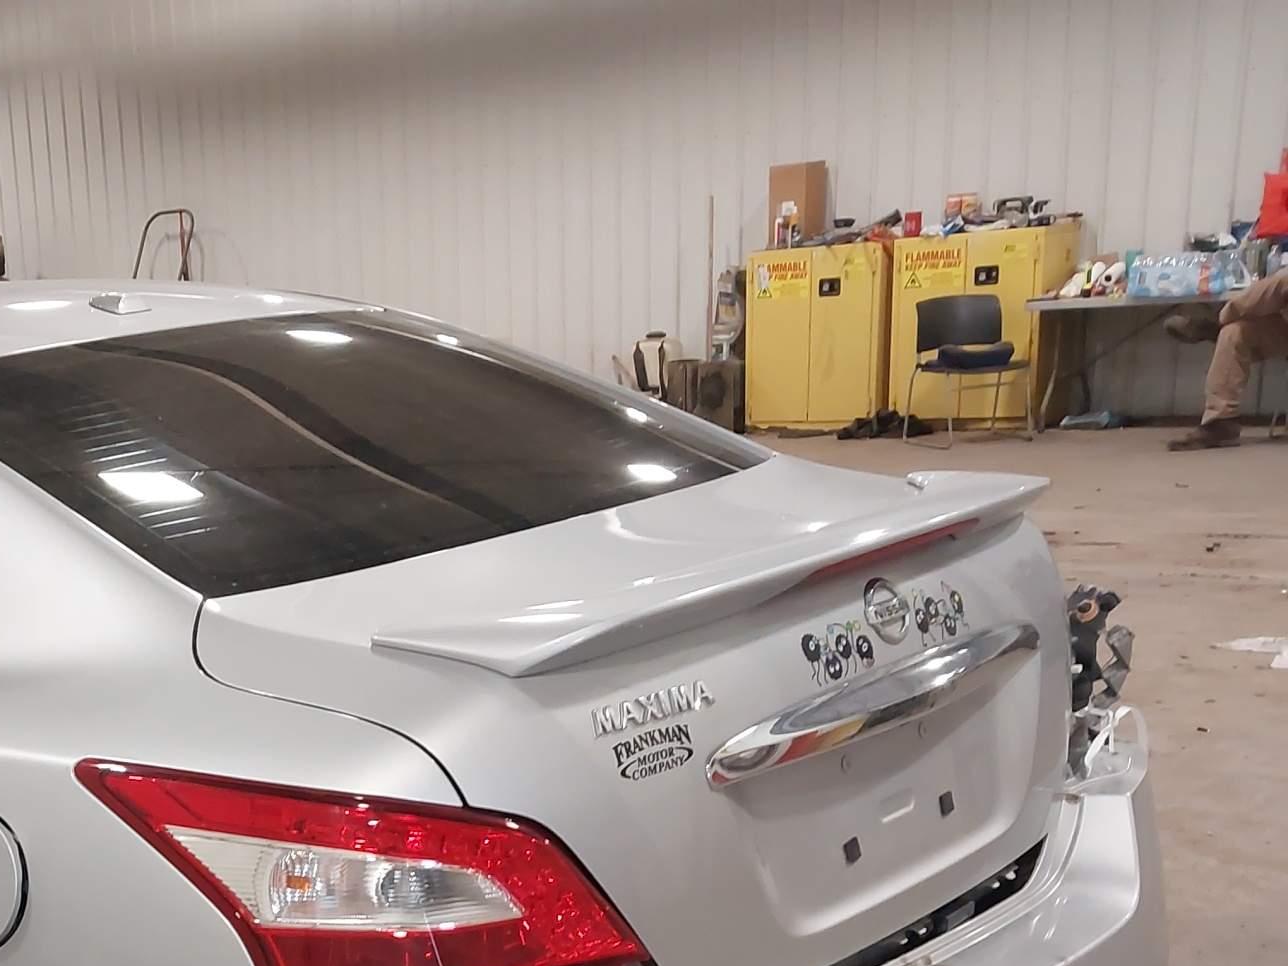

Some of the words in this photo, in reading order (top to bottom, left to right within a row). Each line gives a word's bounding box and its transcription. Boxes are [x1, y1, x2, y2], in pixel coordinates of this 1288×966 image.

[905, 248, 961, 263] FLAMMABLE
[941, 260, 961, 269] AWAY
[757, 261, 807, 273] AMMABLE
[591, 680, 715, 739] MAXIMA
[612, 724, 692, 768] FRANKMAN
[632, 755, 685, 781] COMPANY
[637, 747, 675, 768] MOTOR
